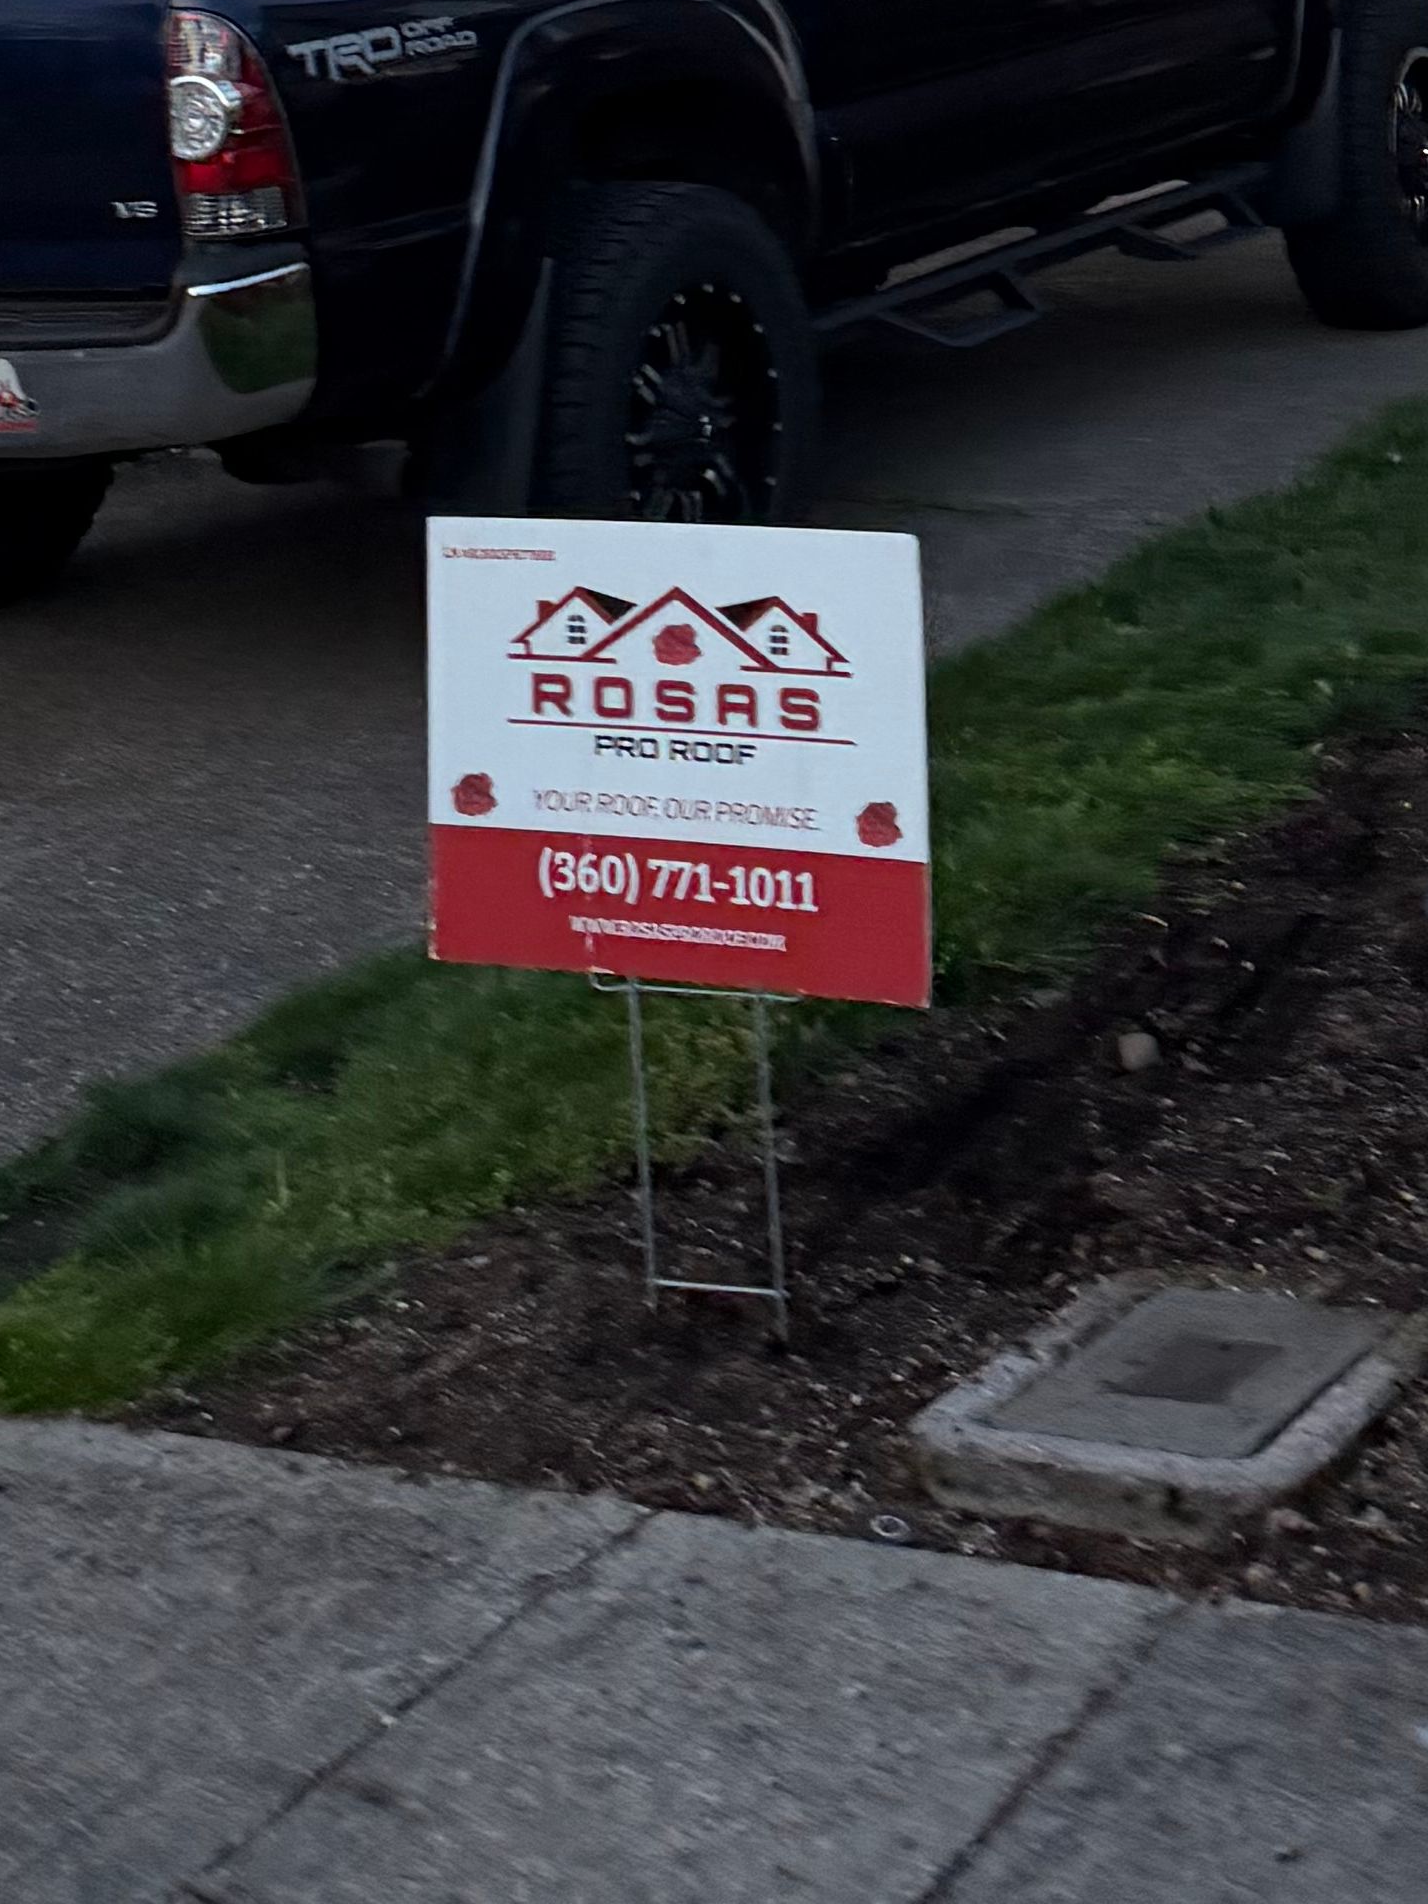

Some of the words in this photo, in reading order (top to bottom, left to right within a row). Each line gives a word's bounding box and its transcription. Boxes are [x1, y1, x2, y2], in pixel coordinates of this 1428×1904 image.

[284, 25, 403, 82] TRD
[530, 672, 823, 732] ROSAS
[593, 734, 659, 759] PRO
[668, 738, 758, 765] ROOF
[534, 789, 593, 812] YOUR
[665, 797, 711, 820] OUR
[539, 846, 640, 905] (360)
[647, 858, 819, 912] 771-1011
